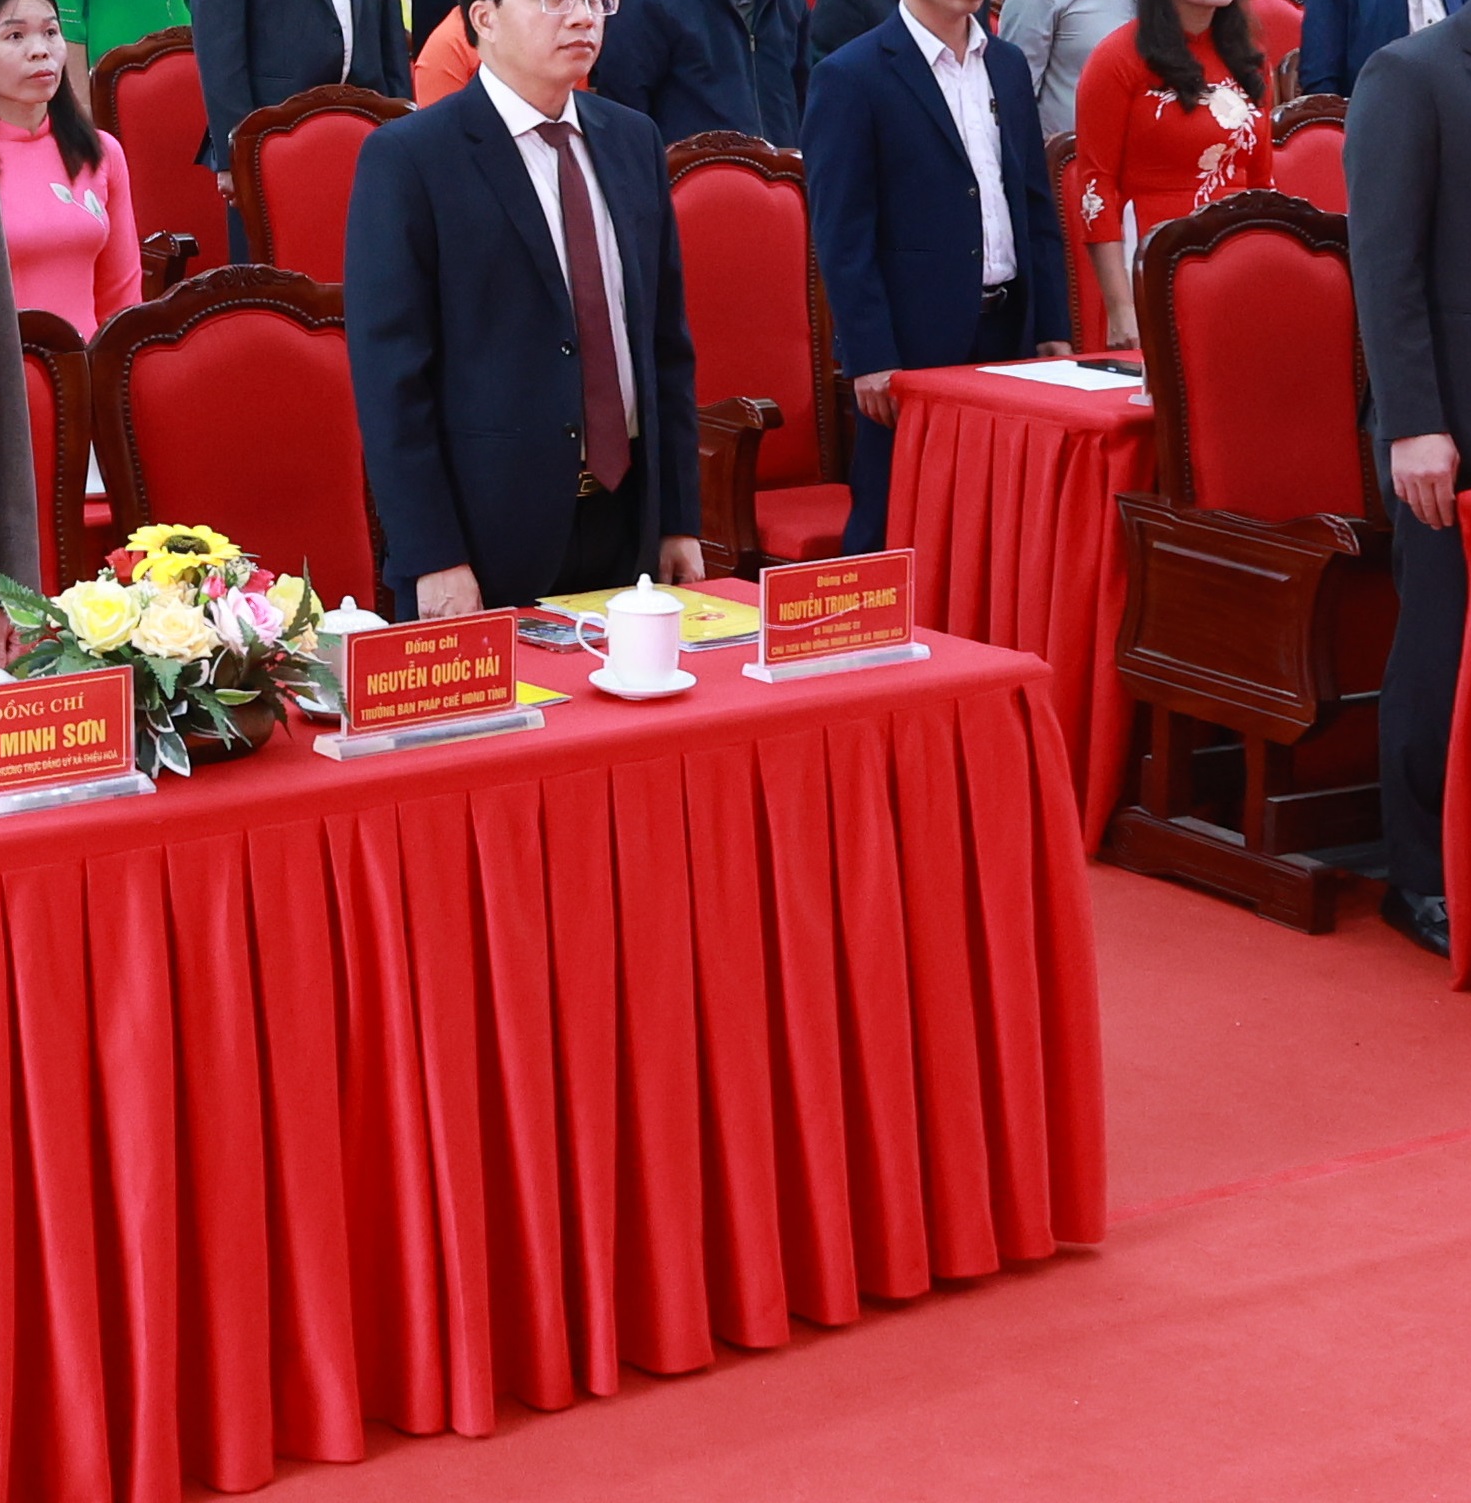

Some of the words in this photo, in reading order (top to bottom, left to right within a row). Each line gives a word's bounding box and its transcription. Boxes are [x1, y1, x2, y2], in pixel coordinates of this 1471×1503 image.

[405, 637, 436, 655] Đồng
[439, 634, 458, 650] chí
[367, 661, 427, 696] NGUYỄN
[432, 654, 471, 687] QUỐC
[475, 647, 500, 678] HẢI
[50, 692, 85, 713] CHÍ
[398, 702, 416, 716] BAN
[0, 726, 56, 758] MINH
[63, 718, 106, 748] SƠN
